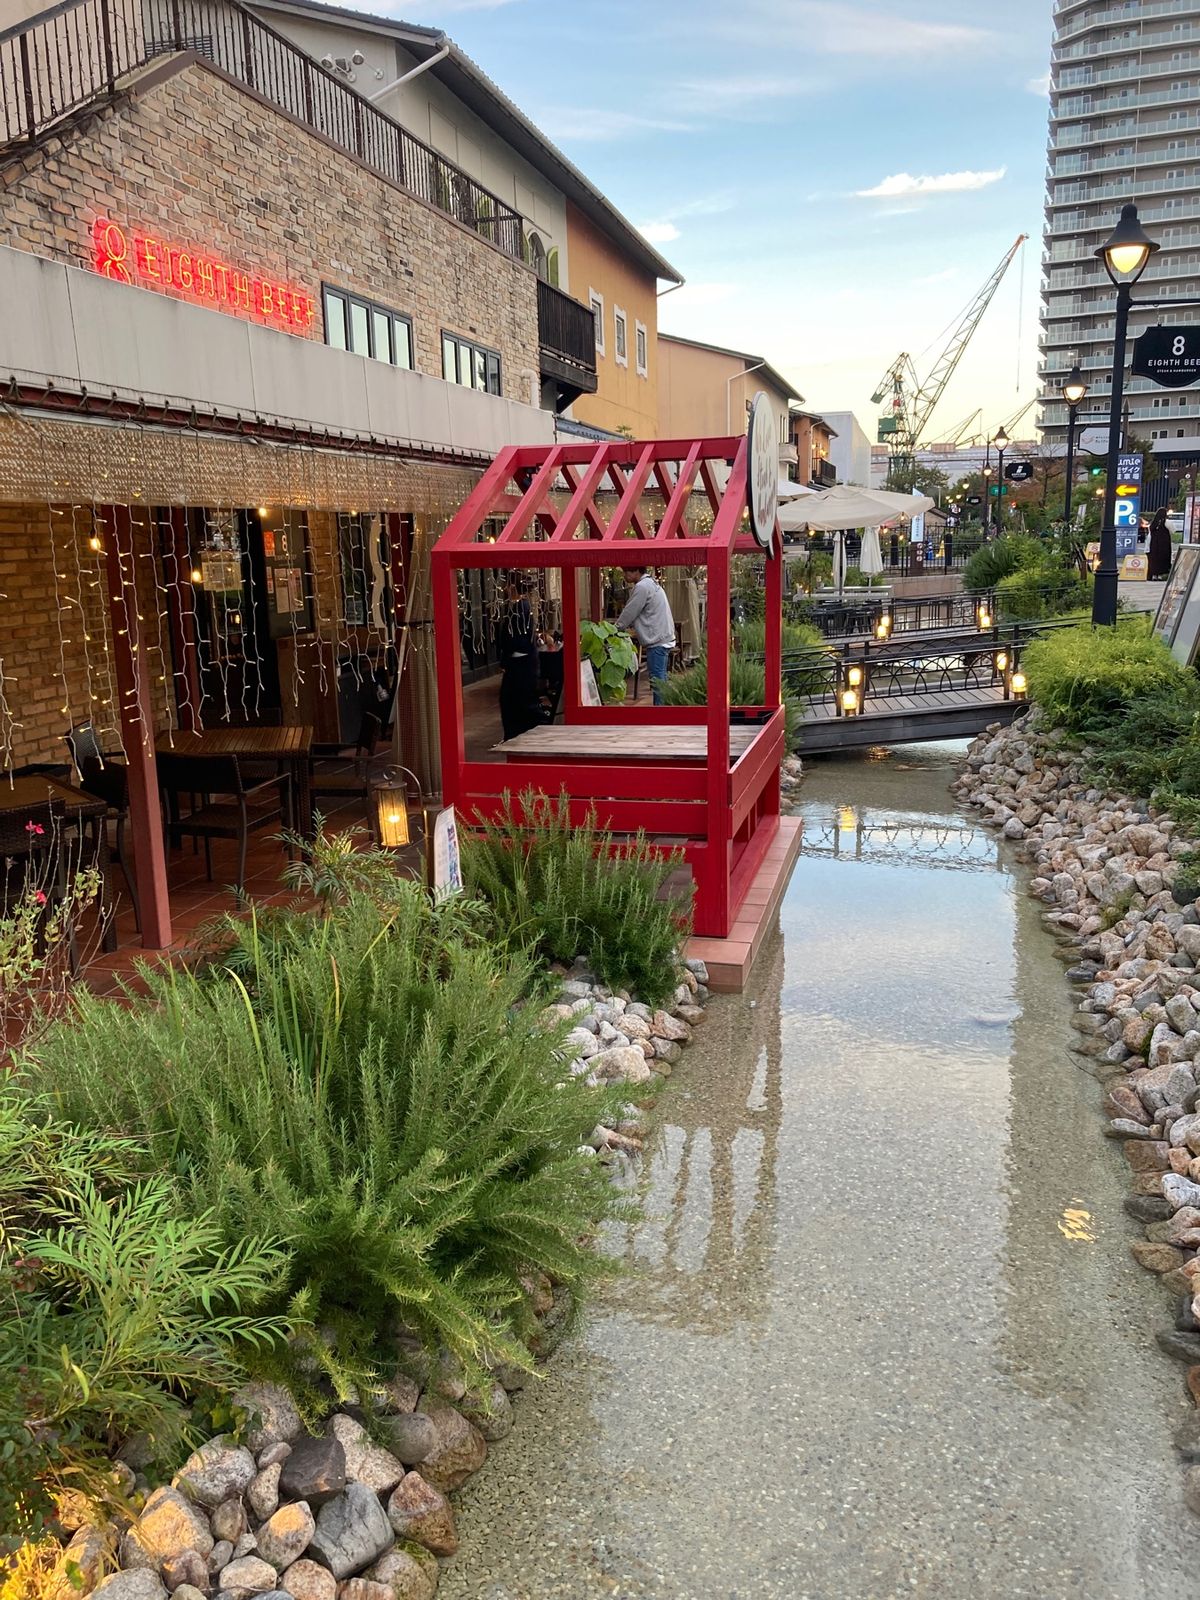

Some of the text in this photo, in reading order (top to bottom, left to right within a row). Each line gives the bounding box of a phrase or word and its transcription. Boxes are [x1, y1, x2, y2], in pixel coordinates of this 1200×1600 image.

[144, 238, 251, 309] EIGHTH
[261, 281, 316, 327] BEEF
[1172, 335, 1185, 356] 8
[1147, 358, 1200, 367] EIGHTH BEE
[282, 535, 288, 552] 8
[1124, 538, 1132, 547] P
